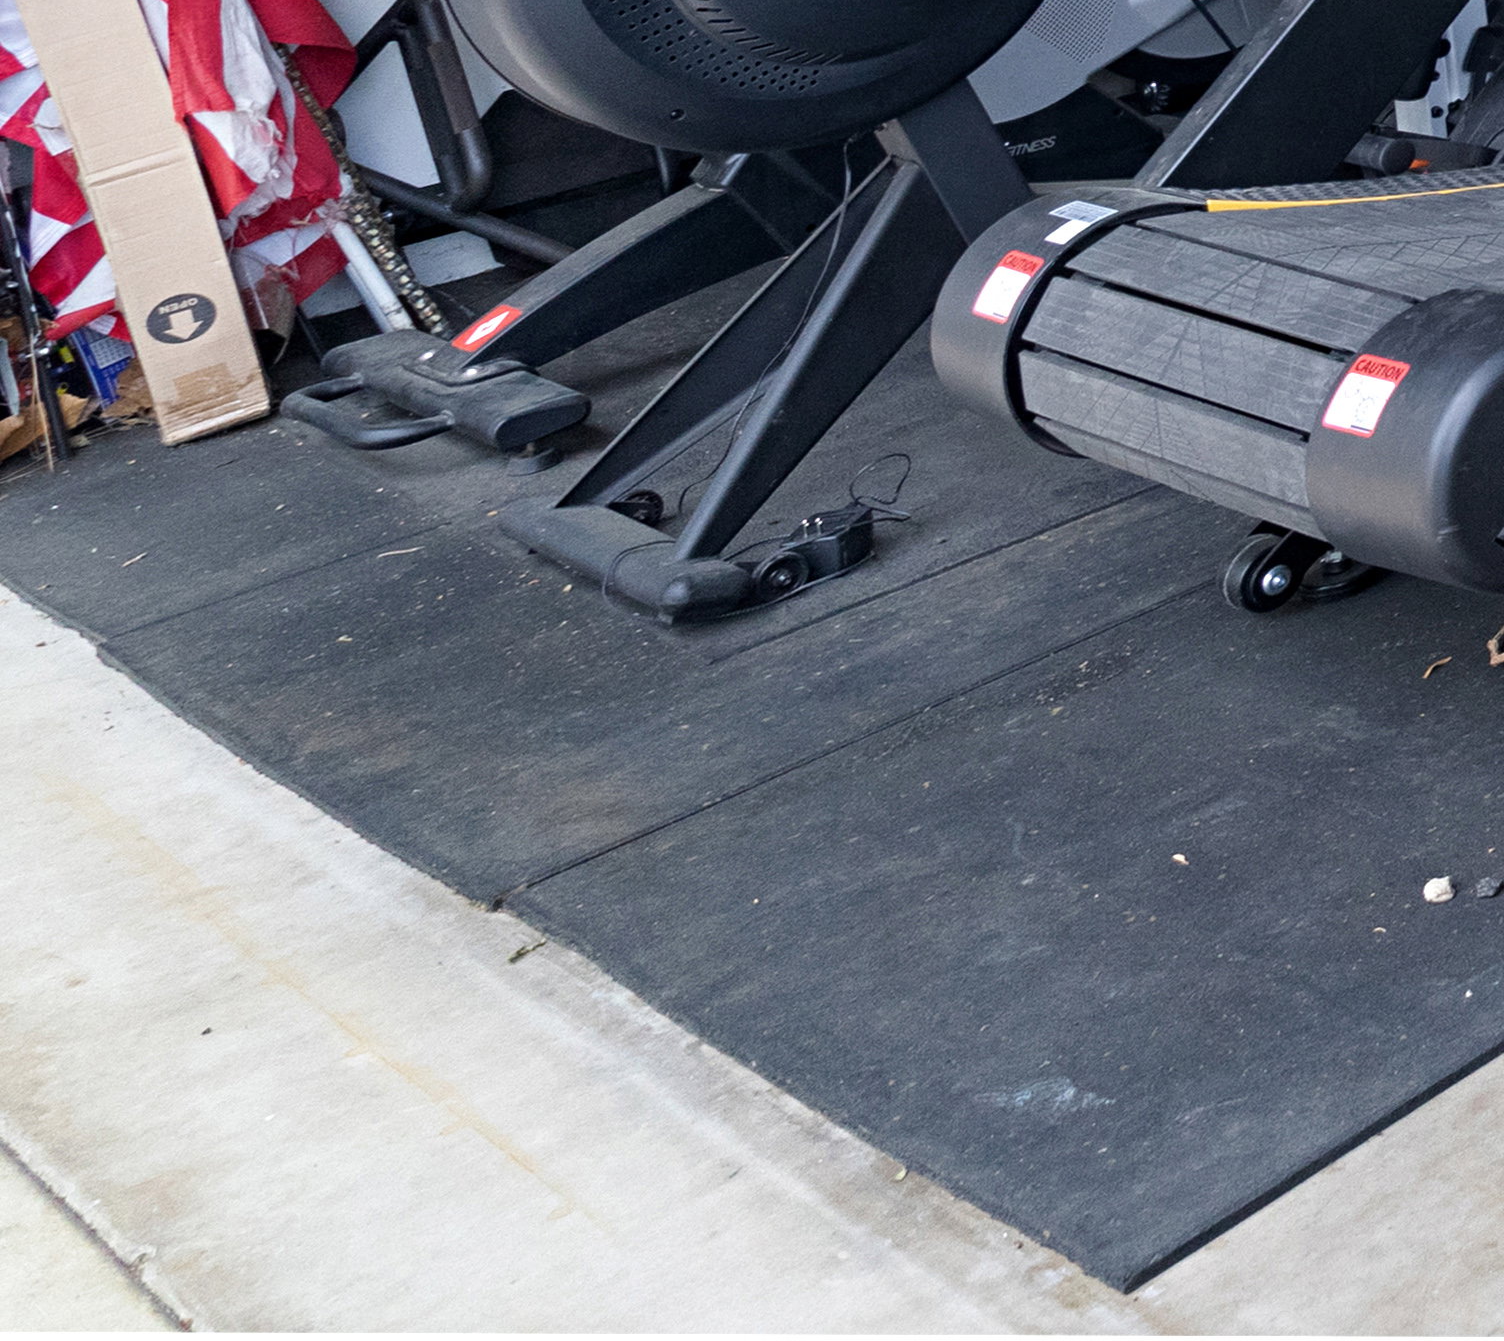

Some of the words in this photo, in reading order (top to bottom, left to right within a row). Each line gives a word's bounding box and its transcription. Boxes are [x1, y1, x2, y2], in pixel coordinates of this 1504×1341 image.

[1003, 253, 1038, 270] CAUTION
[158, 297, 198, 316] OPEN
[1354, 359, 1406, 381] CAUTION
